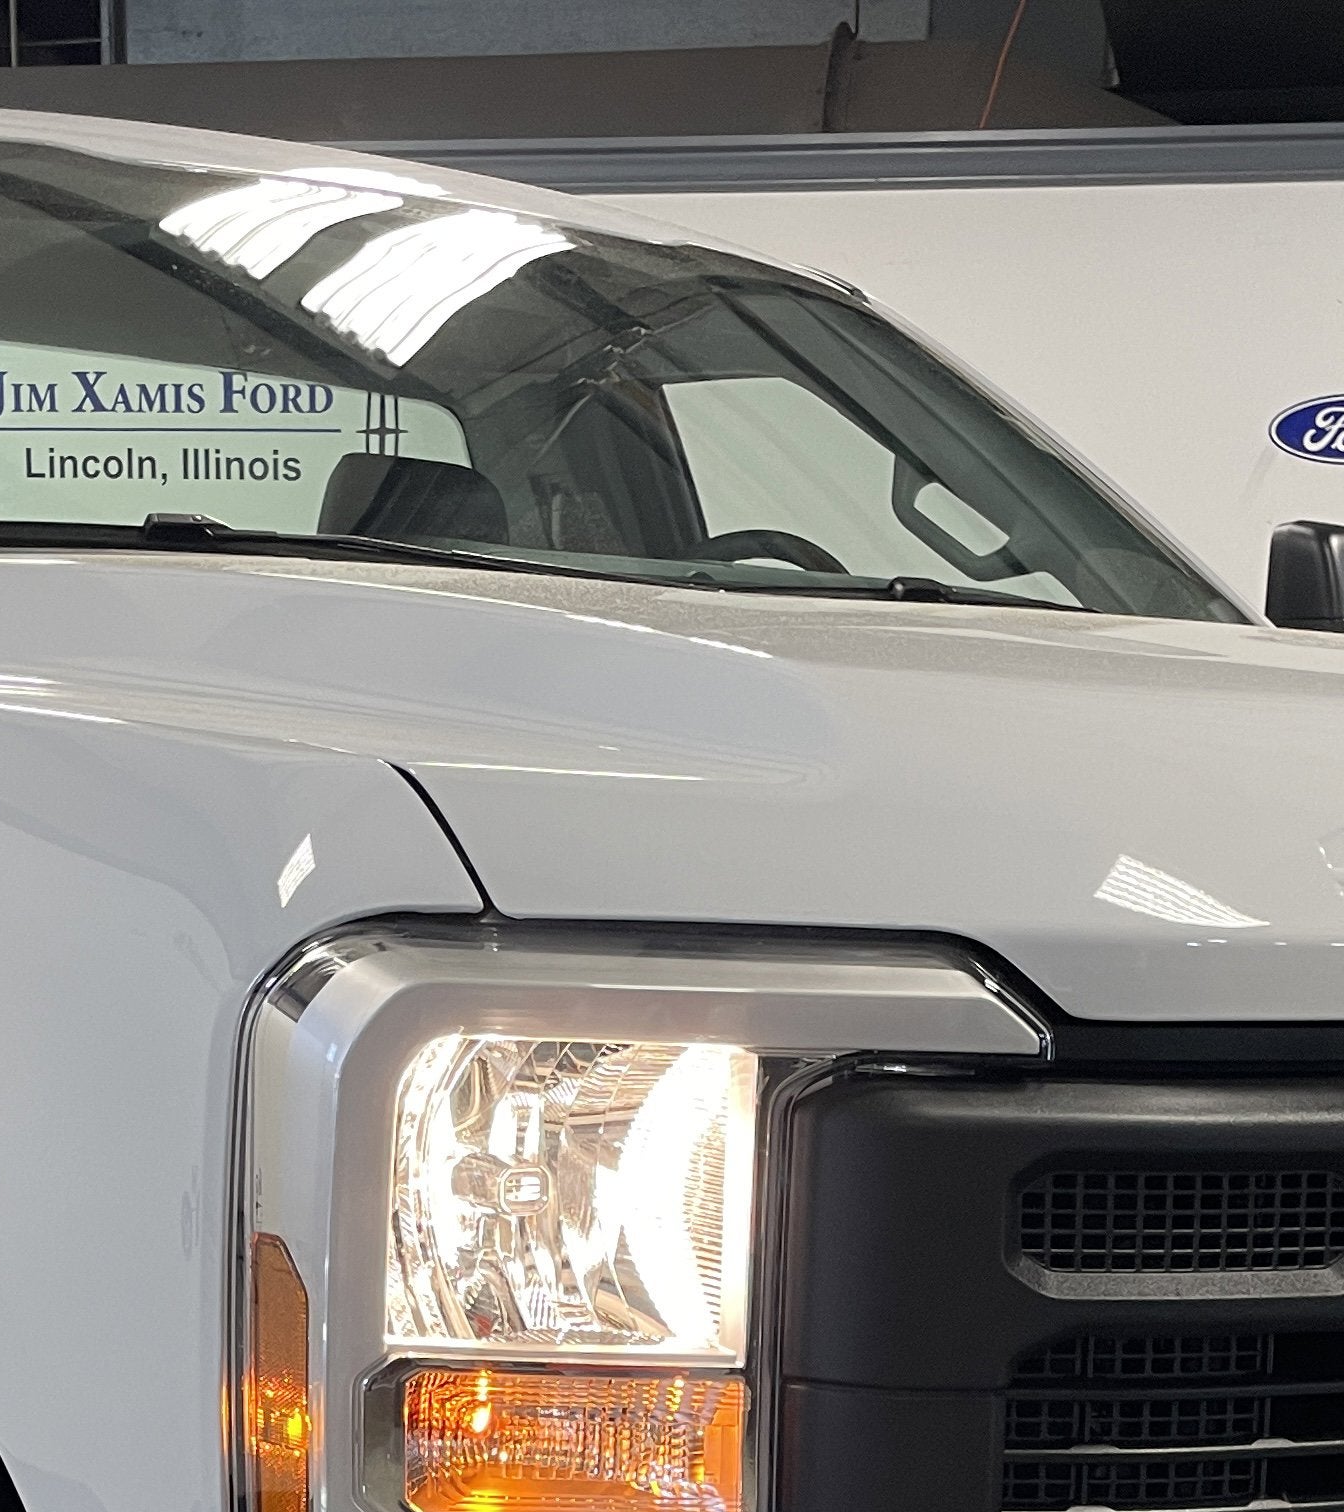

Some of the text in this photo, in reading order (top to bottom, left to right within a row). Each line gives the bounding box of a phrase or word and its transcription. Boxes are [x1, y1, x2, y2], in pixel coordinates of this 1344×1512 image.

[218, 370, 335, 415] FORD
[25, 447, 302, 487] Lincoln, Illinois
